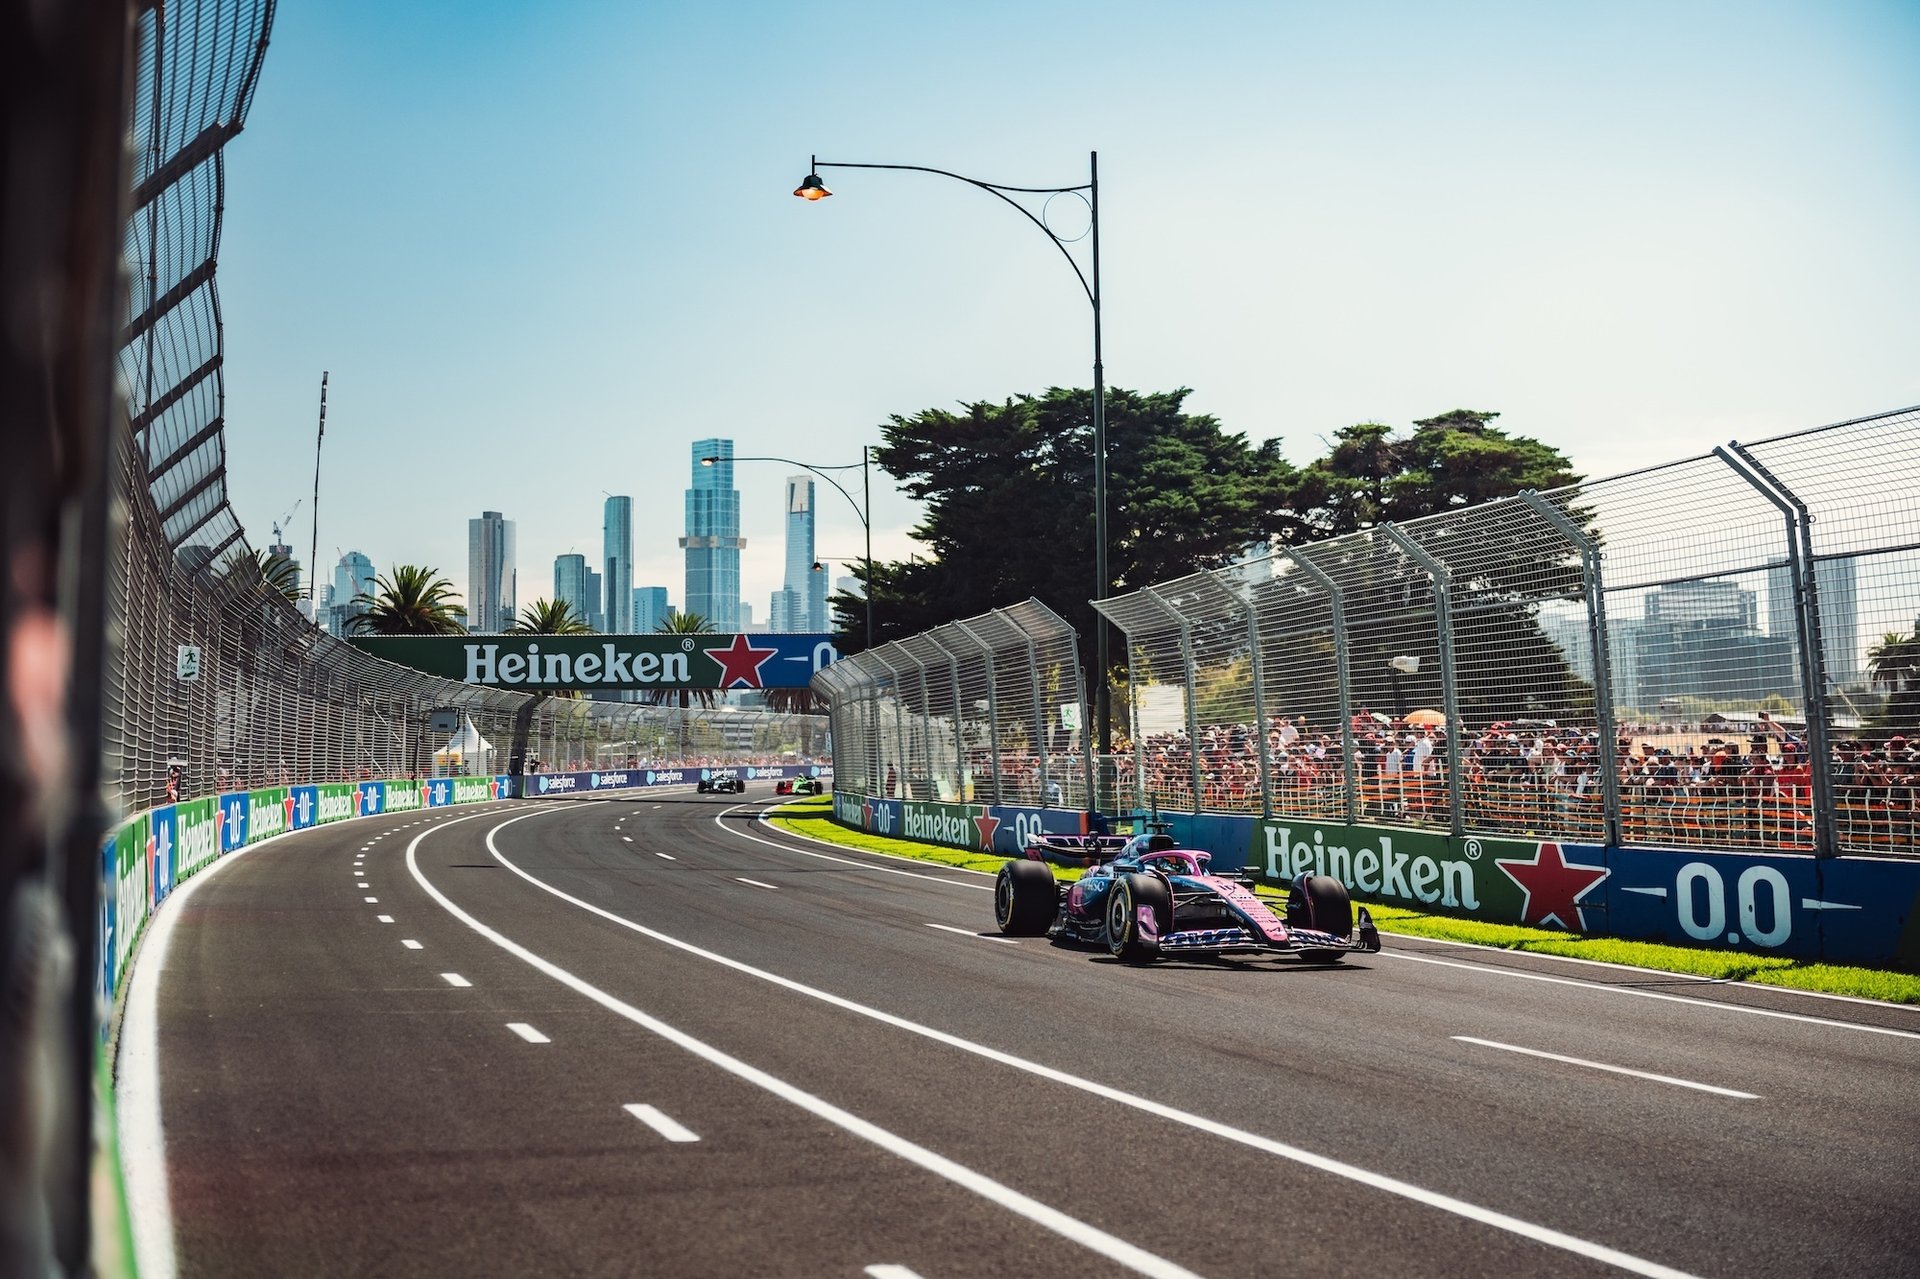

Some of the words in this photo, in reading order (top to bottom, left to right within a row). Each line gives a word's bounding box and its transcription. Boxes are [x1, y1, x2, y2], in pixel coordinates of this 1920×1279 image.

[600, 770, 628, 787] salesforce
[655, 769, 683, 785] salesforce
[756, 766, 783, 779] salesforce
[548, 774, 576, 792] salesforce
[1676, 862, 1792, 948] 0.0
